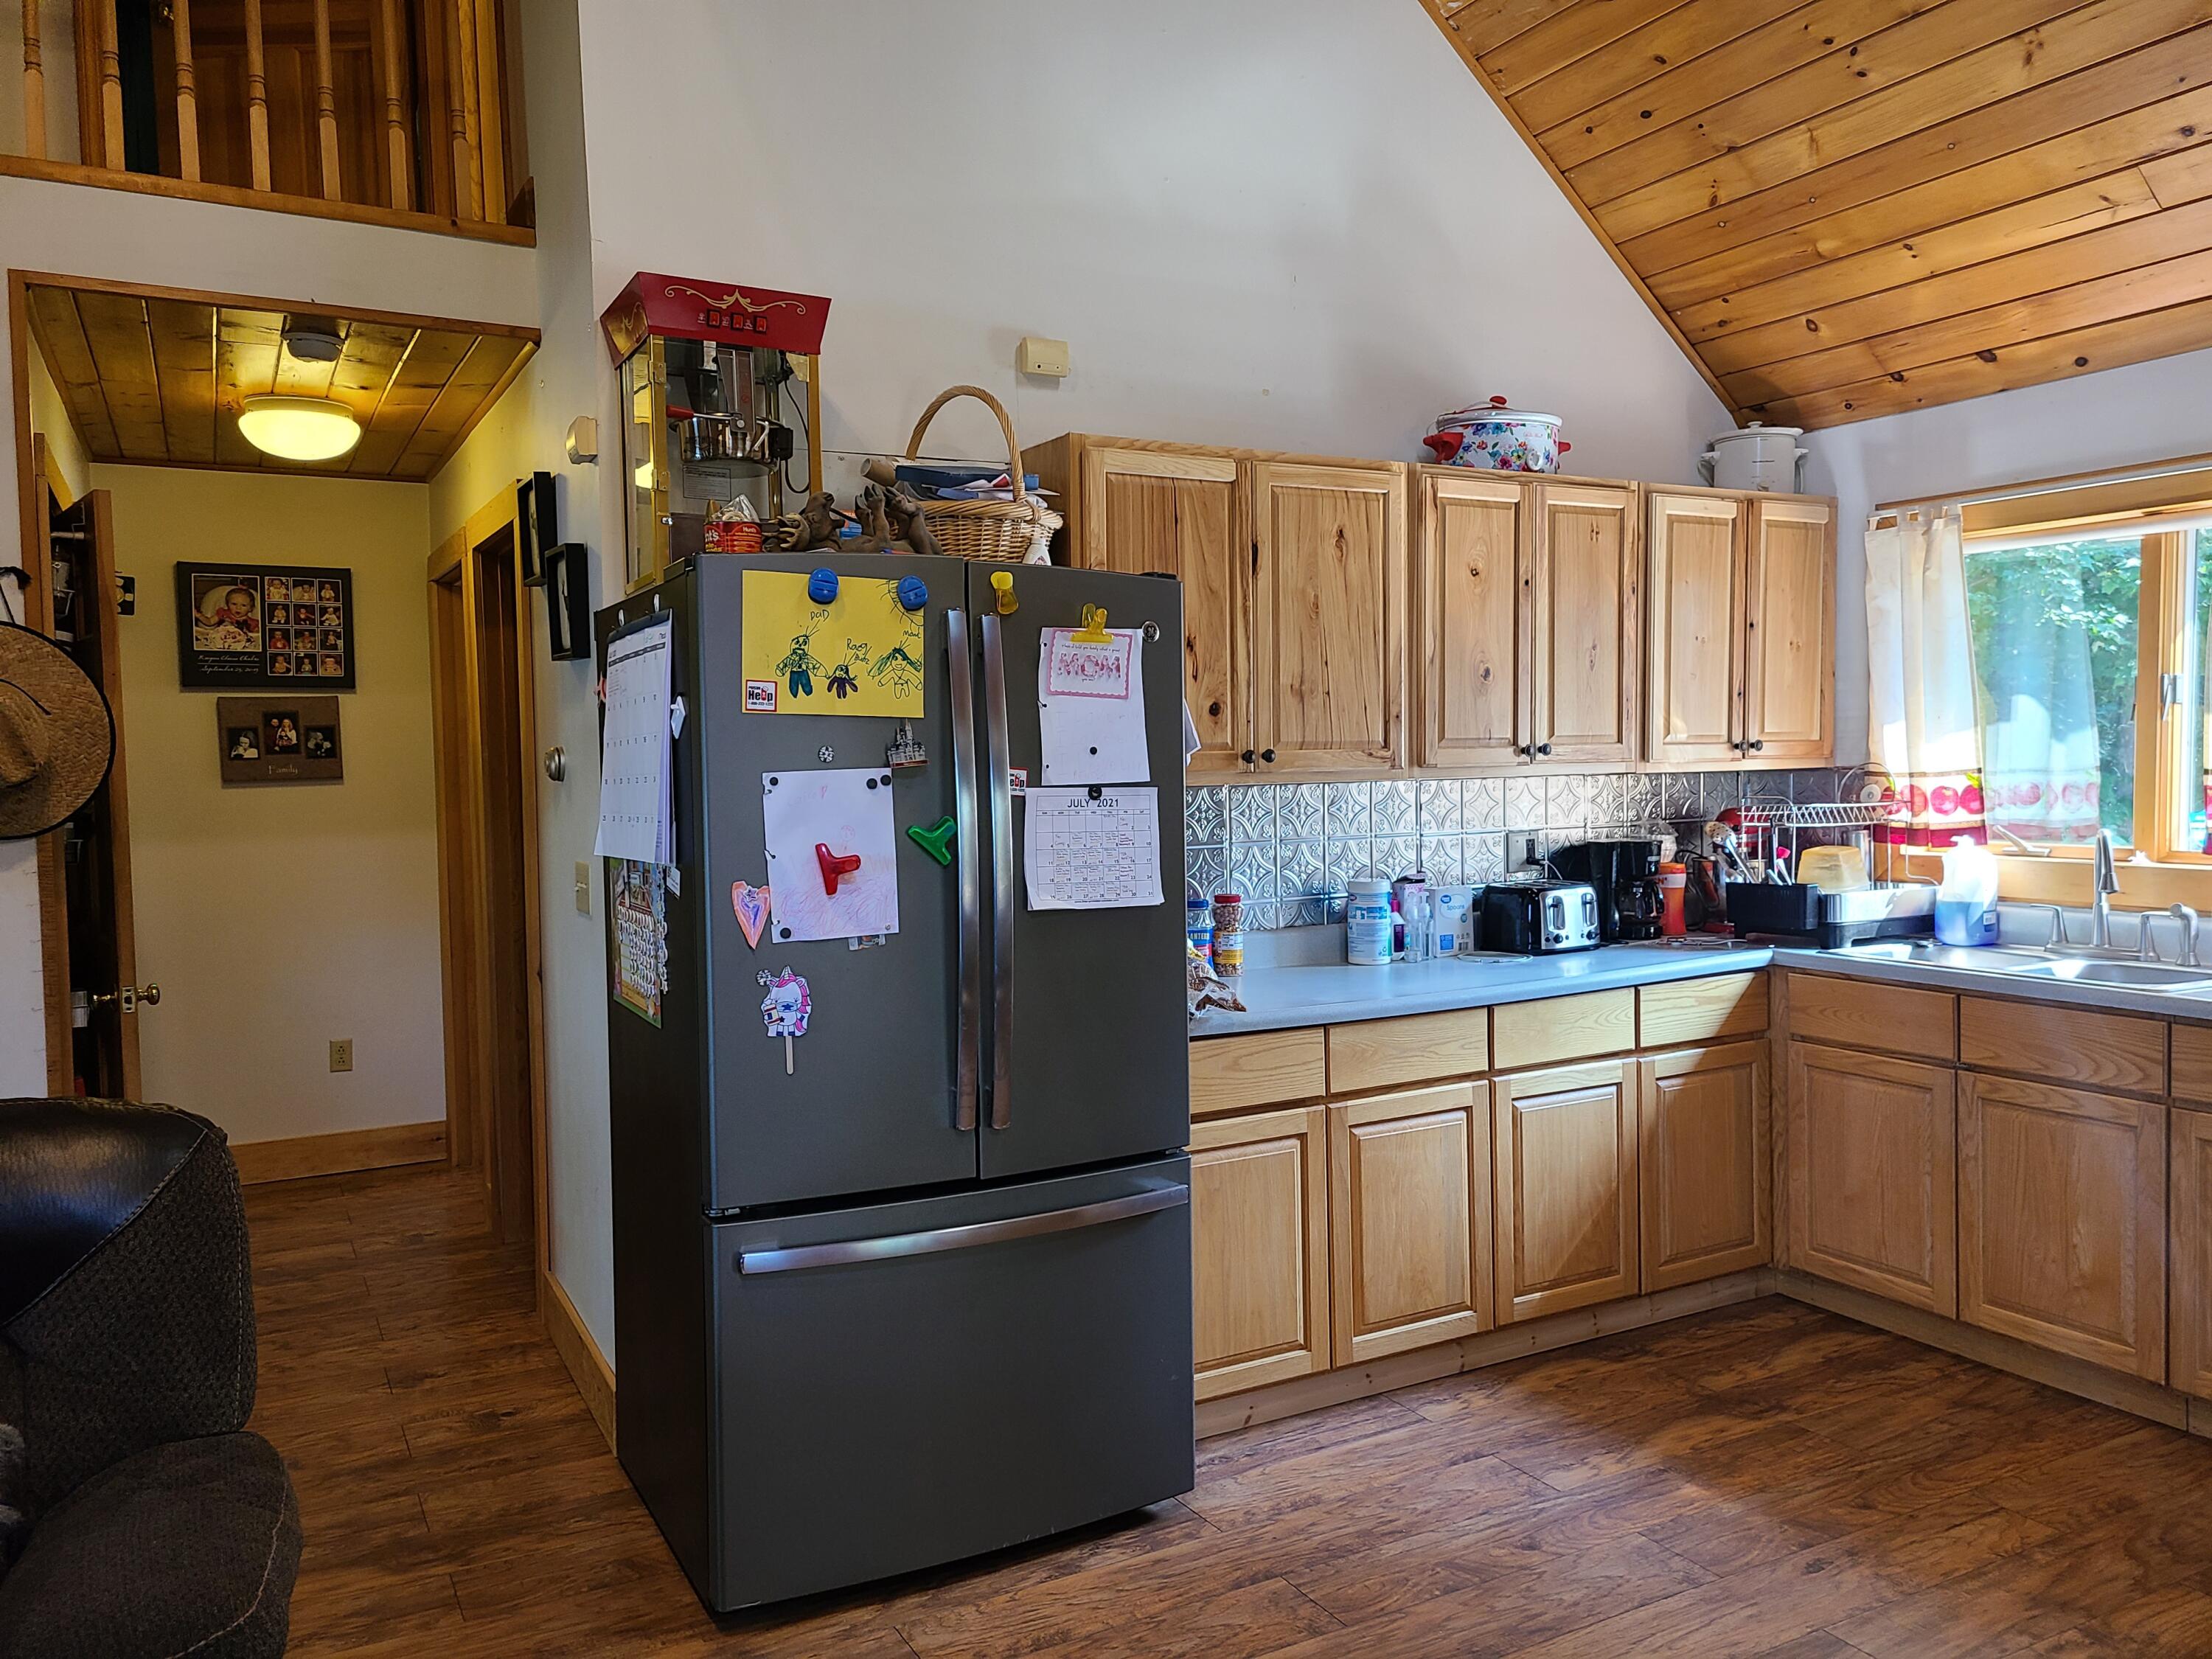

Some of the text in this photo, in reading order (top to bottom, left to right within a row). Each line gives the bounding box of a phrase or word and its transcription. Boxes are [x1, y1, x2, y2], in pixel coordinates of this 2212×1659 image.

[1057, 653, 1121, 678] MOM
[268, 763, 299, 778] Family
[1010, 779, 1024, 787] elp
[1067, 799, 1119, 808] JULY 2021
